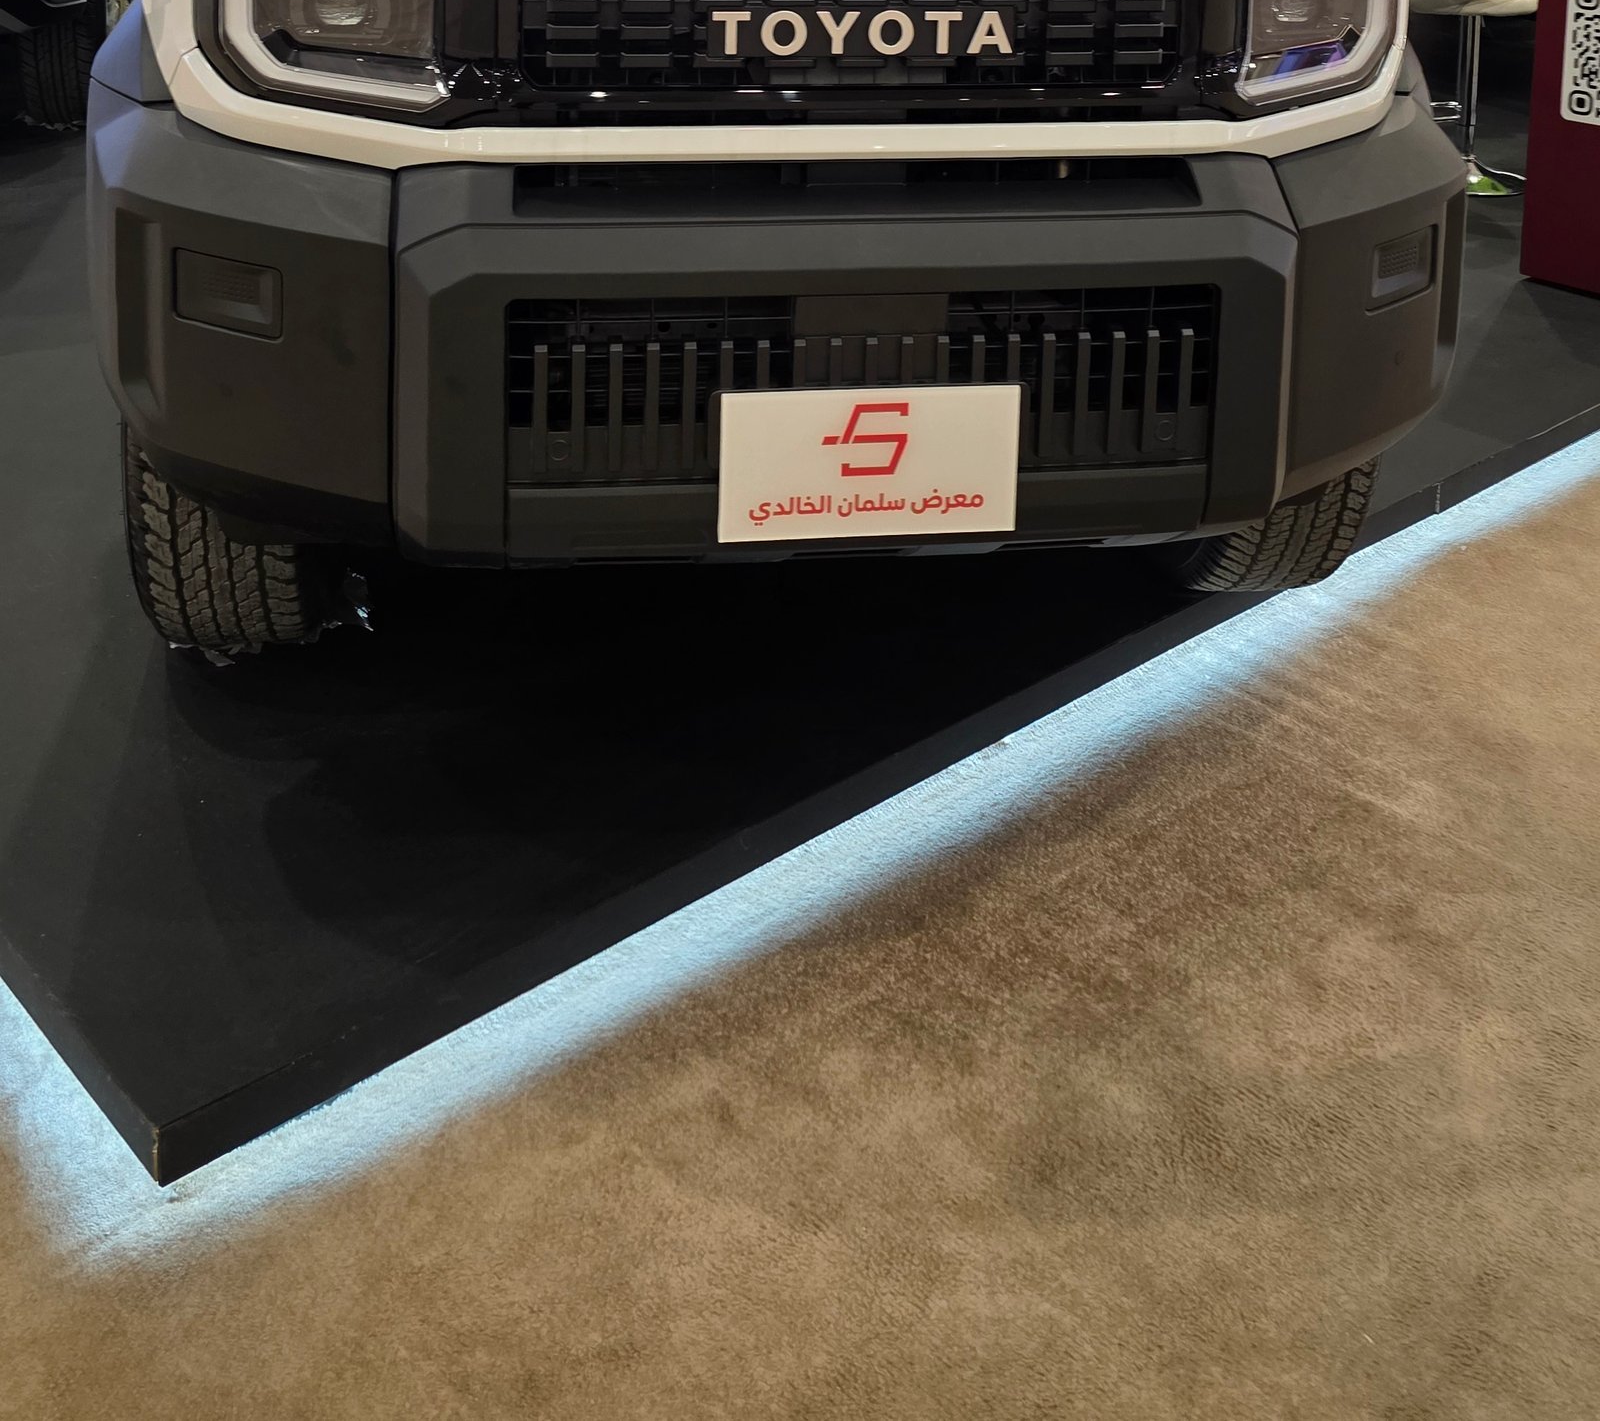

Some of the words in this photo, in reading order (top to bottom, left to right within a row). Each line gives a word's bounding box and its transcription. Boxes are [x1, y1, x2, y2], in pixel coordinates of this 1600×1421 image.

[712, 9, 1013, 56] TOYOTA
[749, 495, 832, 526] الخالدي
[838, 492, 906, 518] سلمان
[910, 489, 985, 515] معرض
